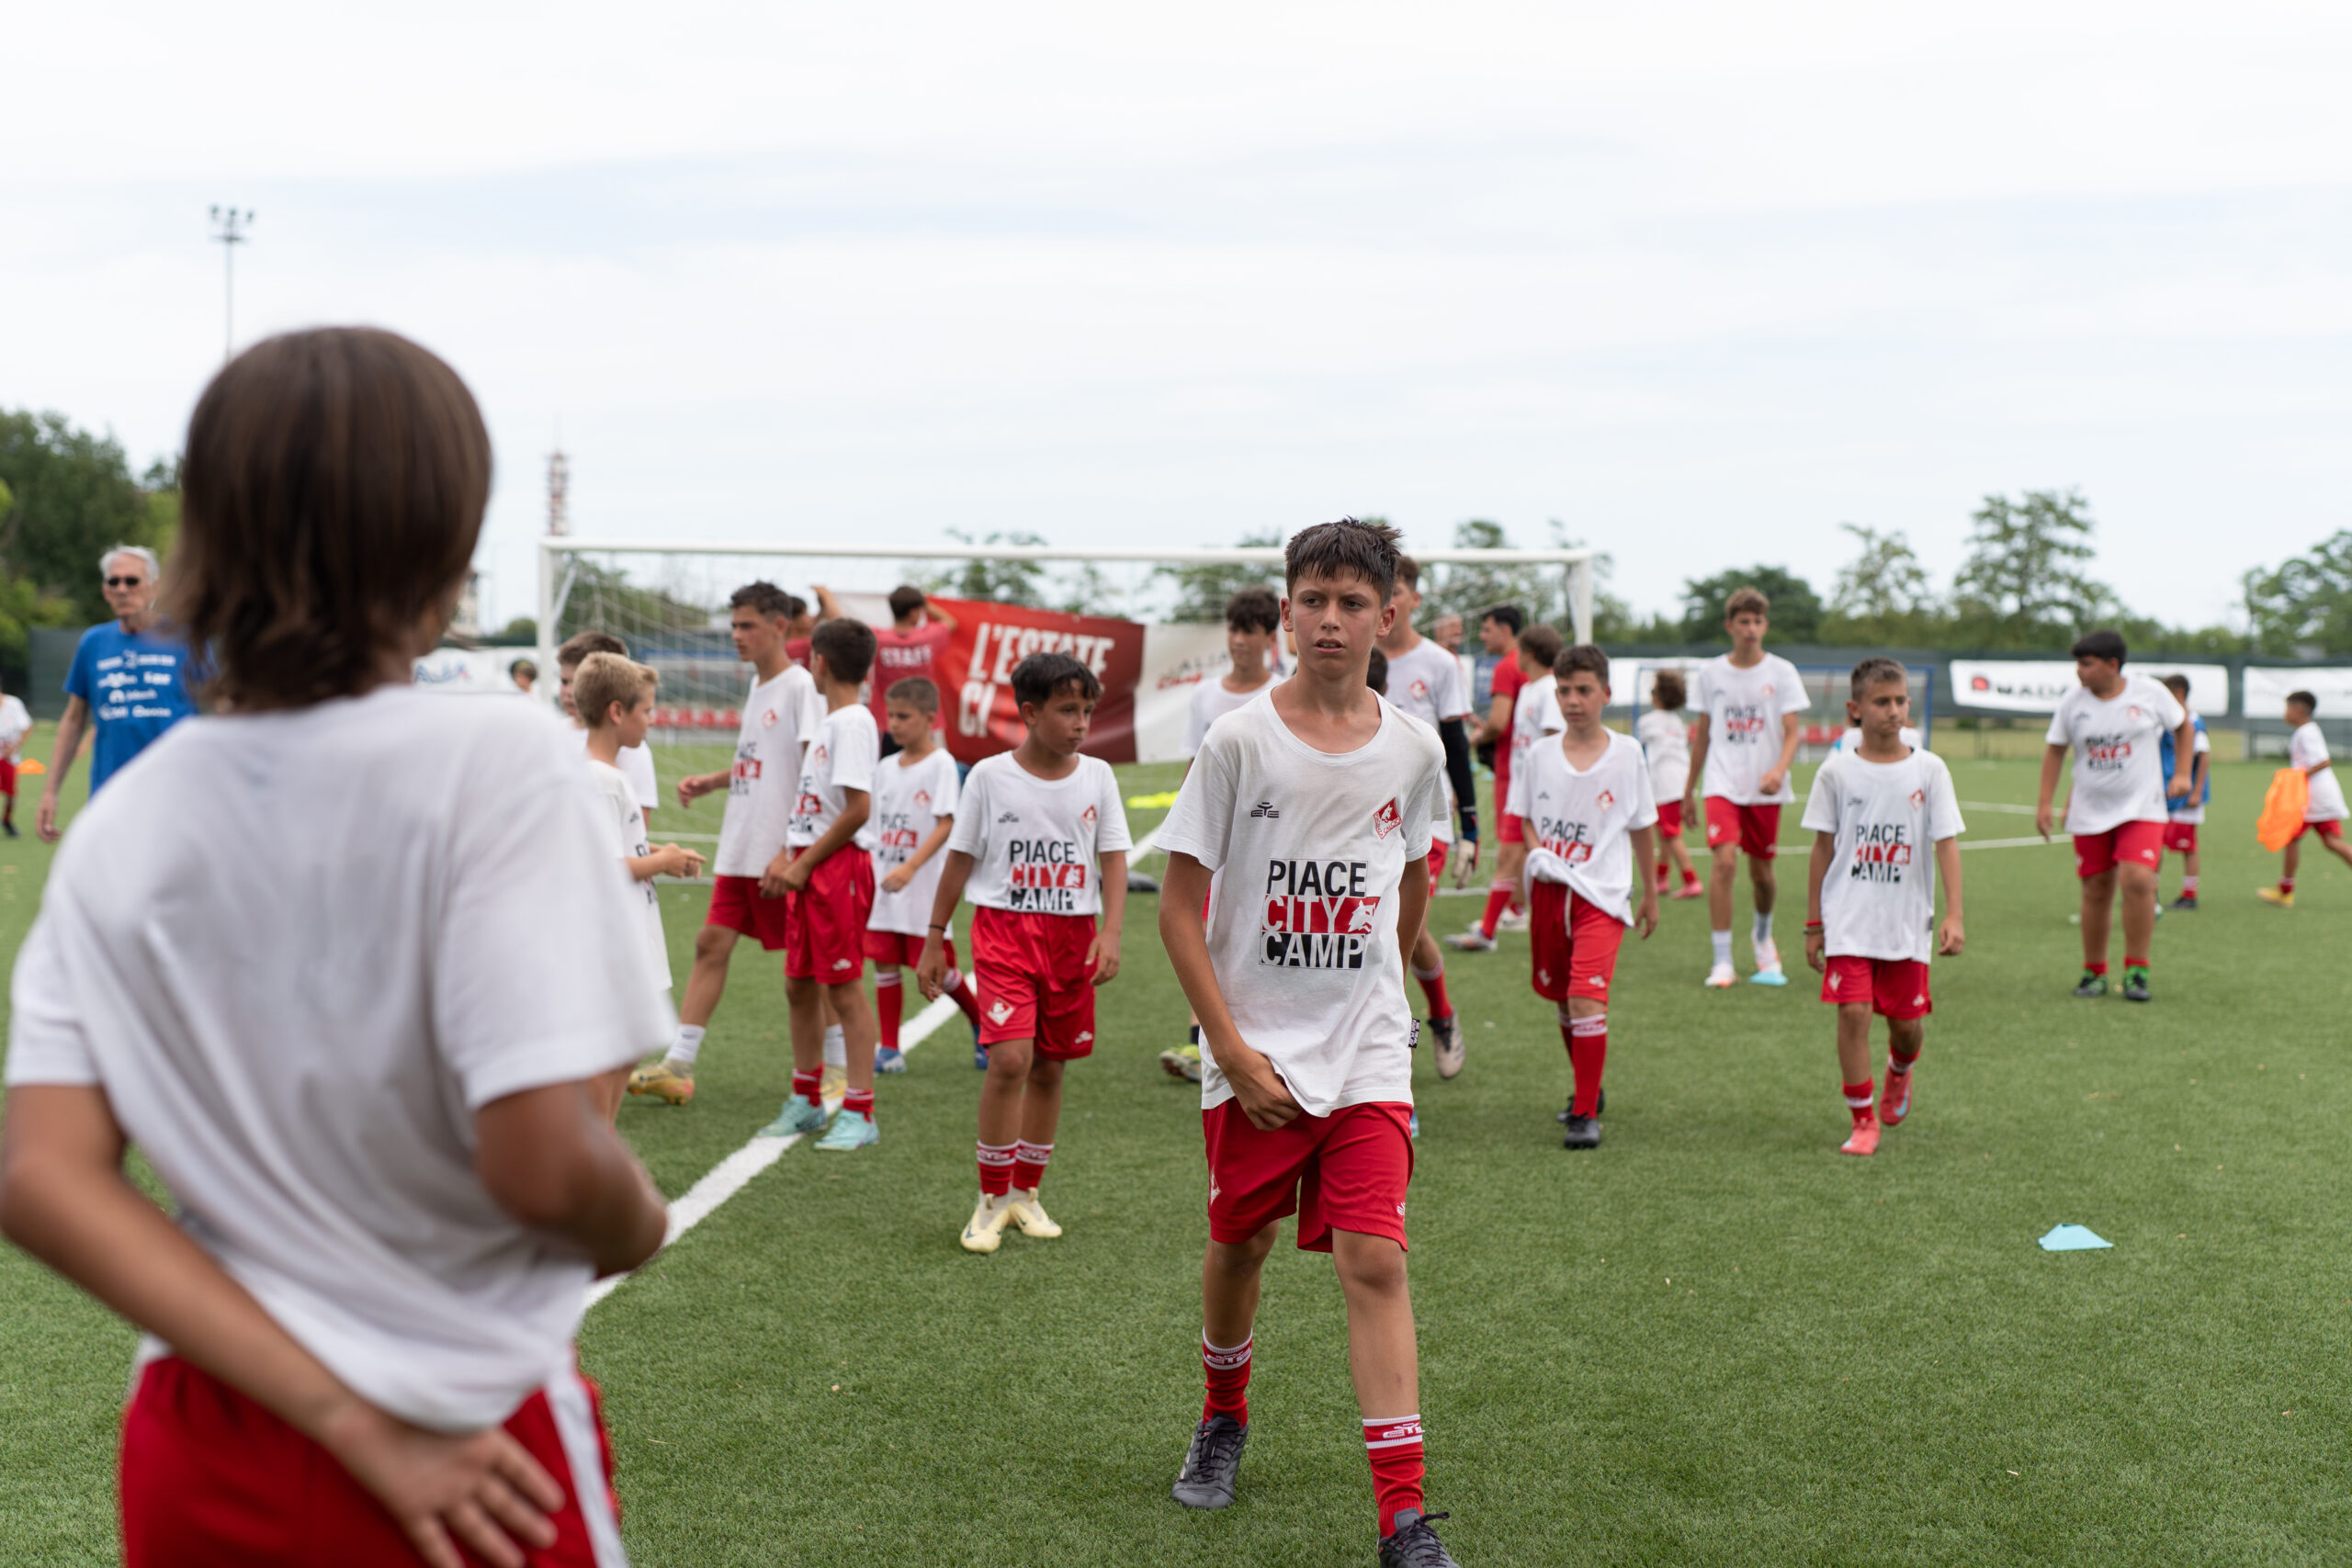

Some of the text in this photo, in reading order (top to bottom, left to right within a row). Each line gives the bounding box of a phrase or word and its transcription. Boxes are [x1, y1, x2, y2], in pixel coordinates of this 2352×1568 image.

[1542, 817, 1588, 844] PACE
[1856, 824, 1905, 844] PIACE
[1010, 840, 1076, 864] PIACE
[1009, 863, 1064, 889] CITY
[1266, 859, 1367, 897] PIACE
[1009, 887, 1074, 910] CAMP
[1261, 894, 1347, 933] CITY
[1260, 931, 1365, 969] CAMP
